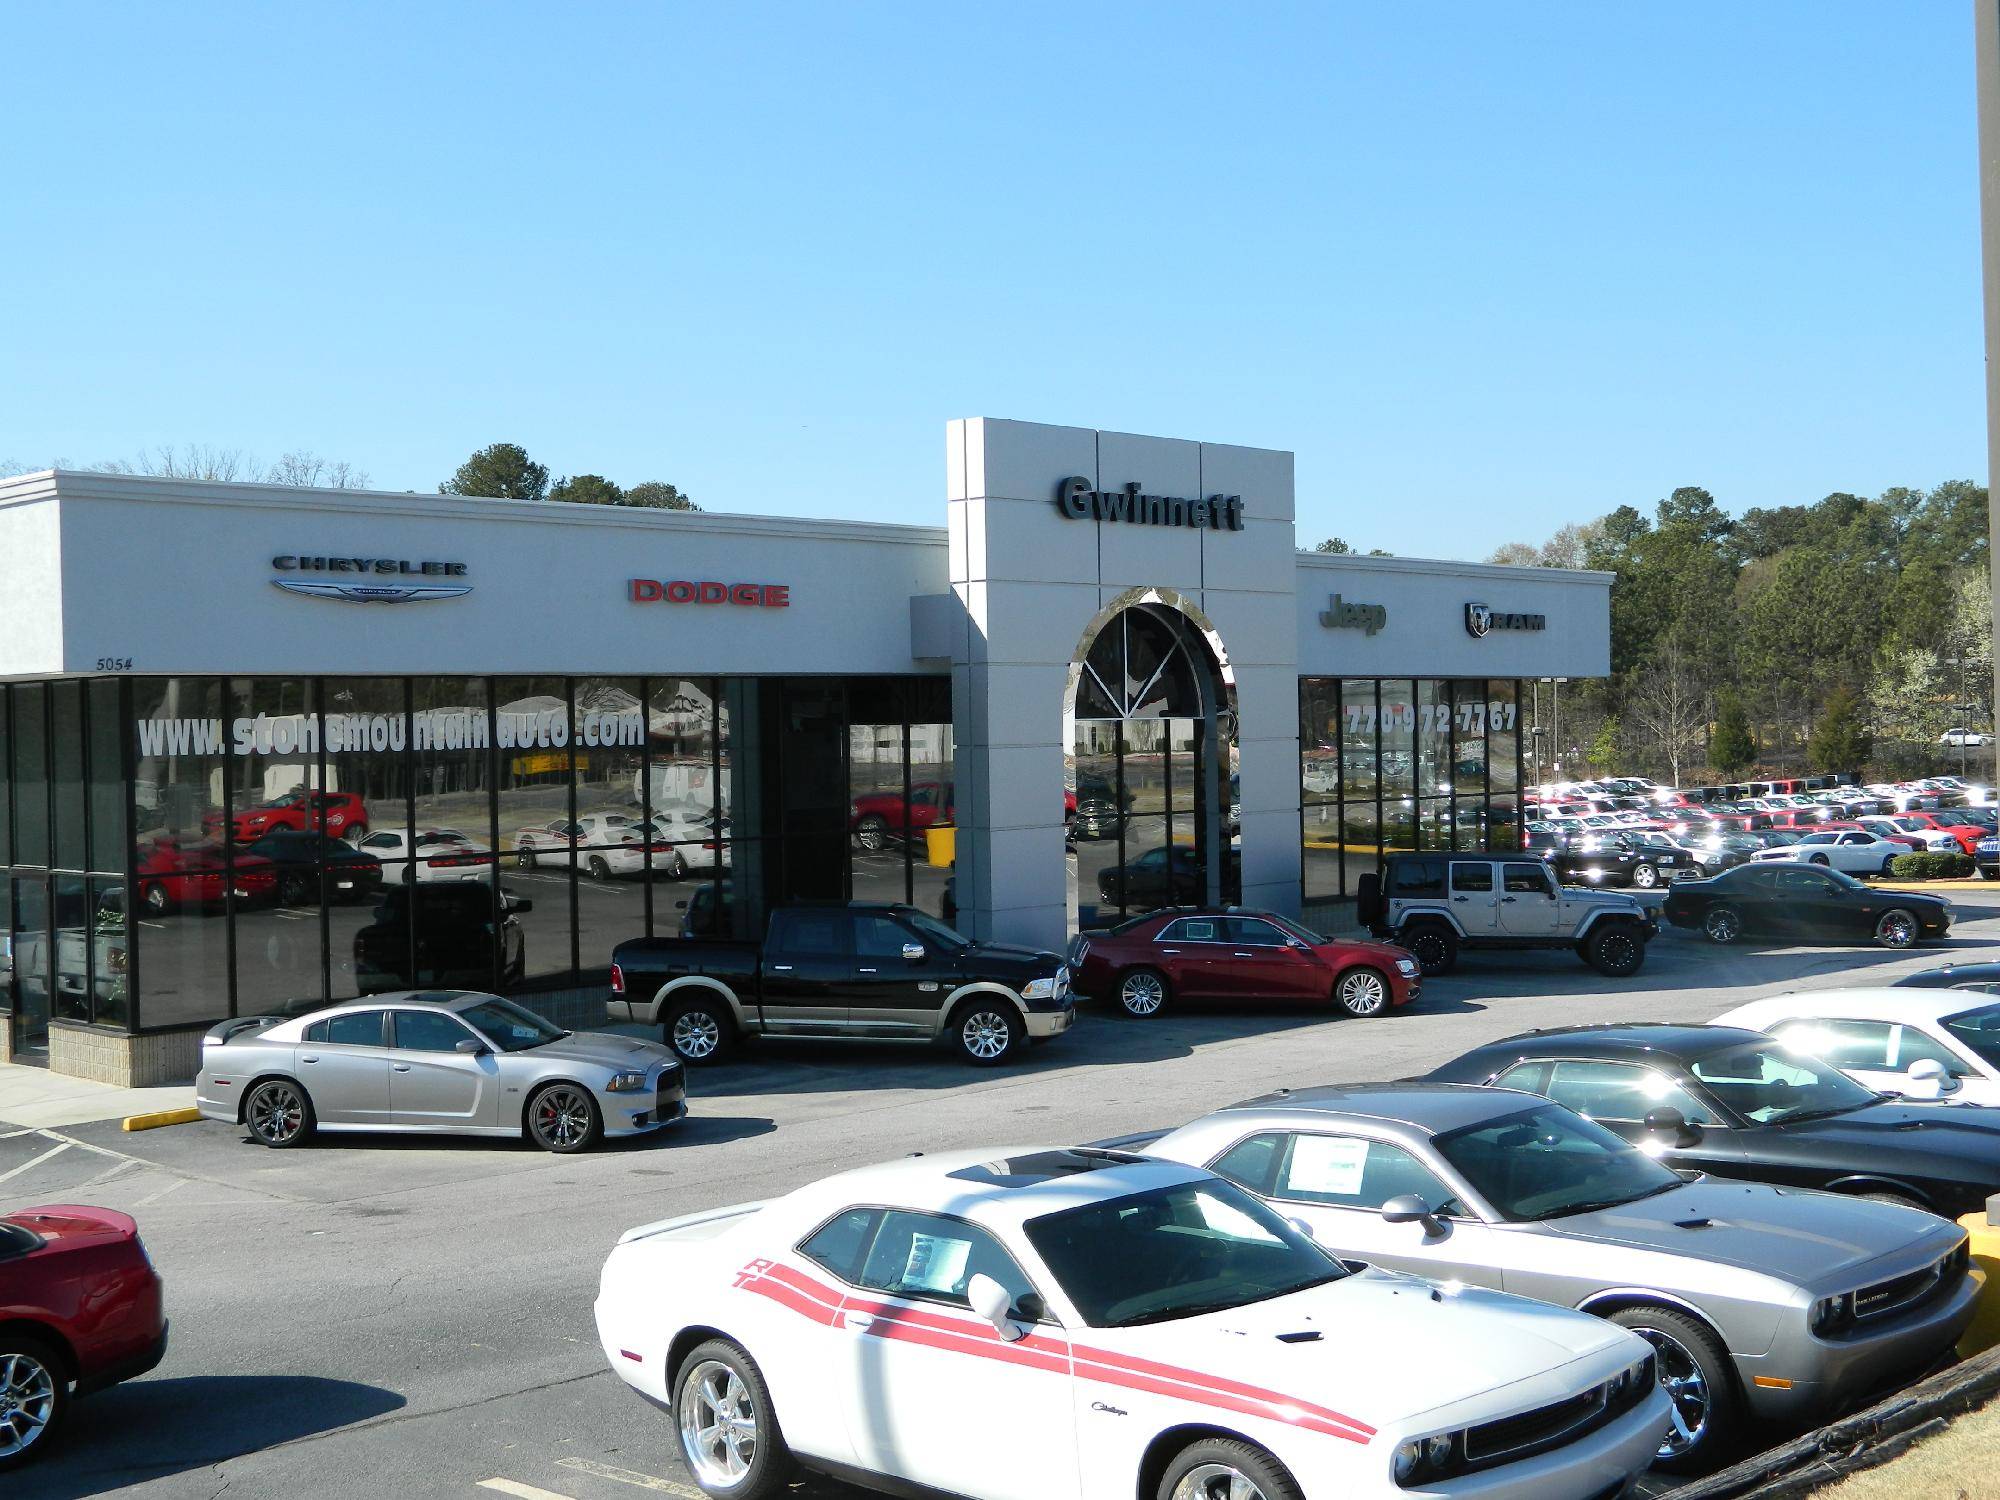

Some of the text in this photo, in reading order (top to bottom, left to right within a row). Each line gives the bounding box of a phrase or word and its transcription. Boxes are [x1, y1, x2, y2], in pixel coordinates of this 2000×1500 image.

[1058, 476, 1244, 531] Gwinnett
[272, 555, 468, 576] CHRYSLER
[630, 579, 790, 607] DODGE
[1319, 593, 1387, 636] Jeep
[1490, 612, 1546, 631] RAM
[96, 657, 133, 671] 5054
